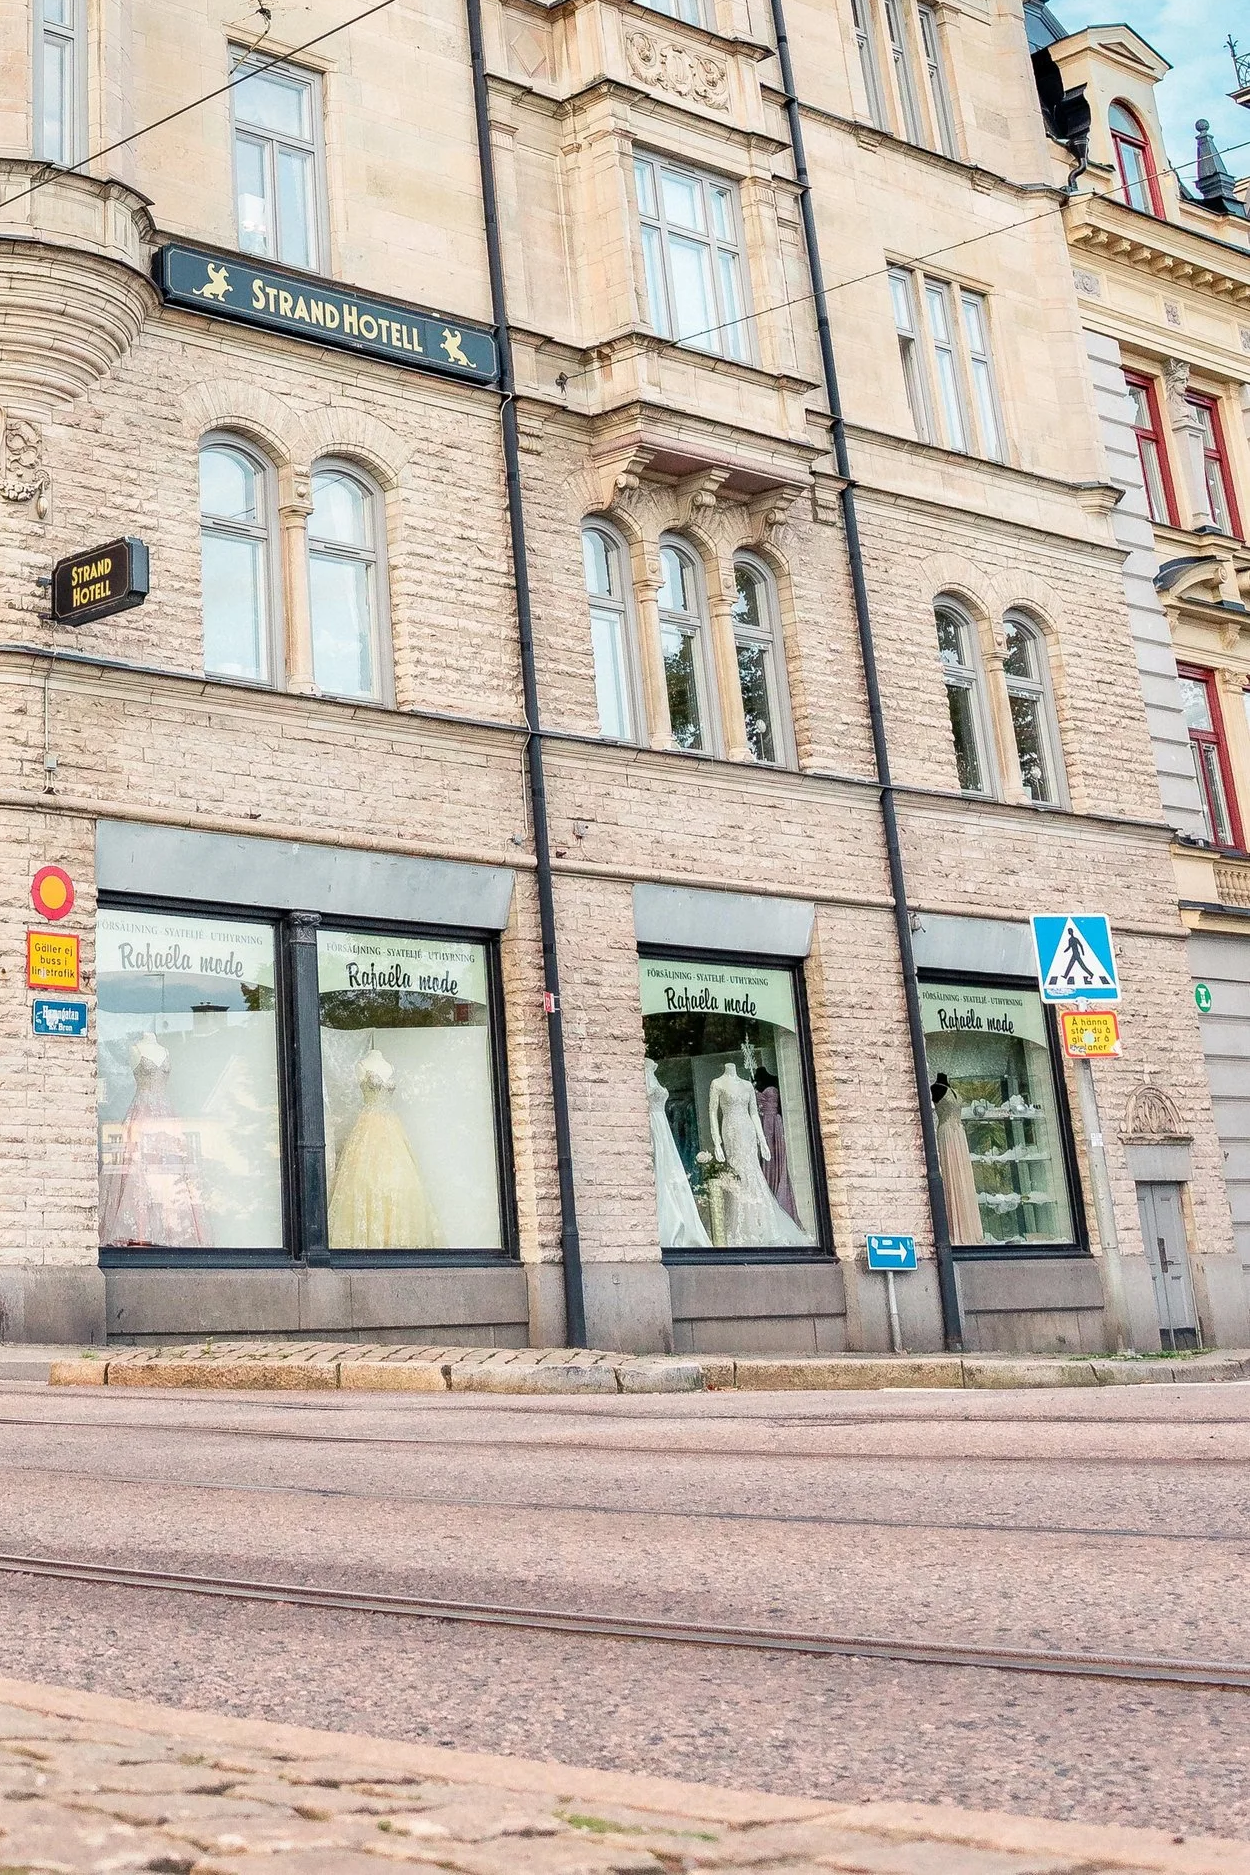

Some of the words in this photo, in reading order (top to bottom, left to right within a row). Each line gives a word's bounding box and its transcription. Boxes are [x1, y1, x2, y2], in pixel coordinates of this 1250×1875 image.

[252, 278, 340, 329] STRAND
[343, 303, 423, 353] HOTELL
[71, 558, 112, 586] STRAND
[72, 580, 111, 607] HOTELL
[164, 927, 204, 940] SYATELJÉ
[210, 932, 263, 945] UTHYRNING
[34, 942, 62, 954] Gäller
[64, 945, 73, 956] ej
[326, 942, 381, 956] FÖRSÄLJNING
[386, 948, 422, 960] SYATELJÉ
[428, 951, 475, 963] UTHYRNING
[40, 955, 62, 965] buss
[64, 957, 67, 965] i
[118, 942, 193, 972] Rafaéla
[199, 951, 244, 978] mode
[31, 966, 75, 978] linjetrafik
[345, 962, 412, 990] Rafaéla
[419, 970, 459, 995] mode
[647, 968, 692, 980] FÖRSÄLJNING
[696, 973, 726, 984] SYATELJÉ
[730, 975, 769, 986] UTHYRNING
[664, 986, 719, 1012] Rafaéla
[724, 993, 757, 1016] mode
[922, 991, 960, 1002] FÖRSÄLJNING
[990, 997, 1023, 1006] UTHYRNING
[42, 1005, 79, 1021] Hngatan
[937, 1008, 983, 1031] Rafaéla
[986, 1013, 1015, 1034] mode
[1071, 1016, 1078, 1026] Å
[1080, 1017, 1108, 1026] hänna
[58, 1023, 73, 1032] Bron
[1091, 1026, 1102, 1034] du
